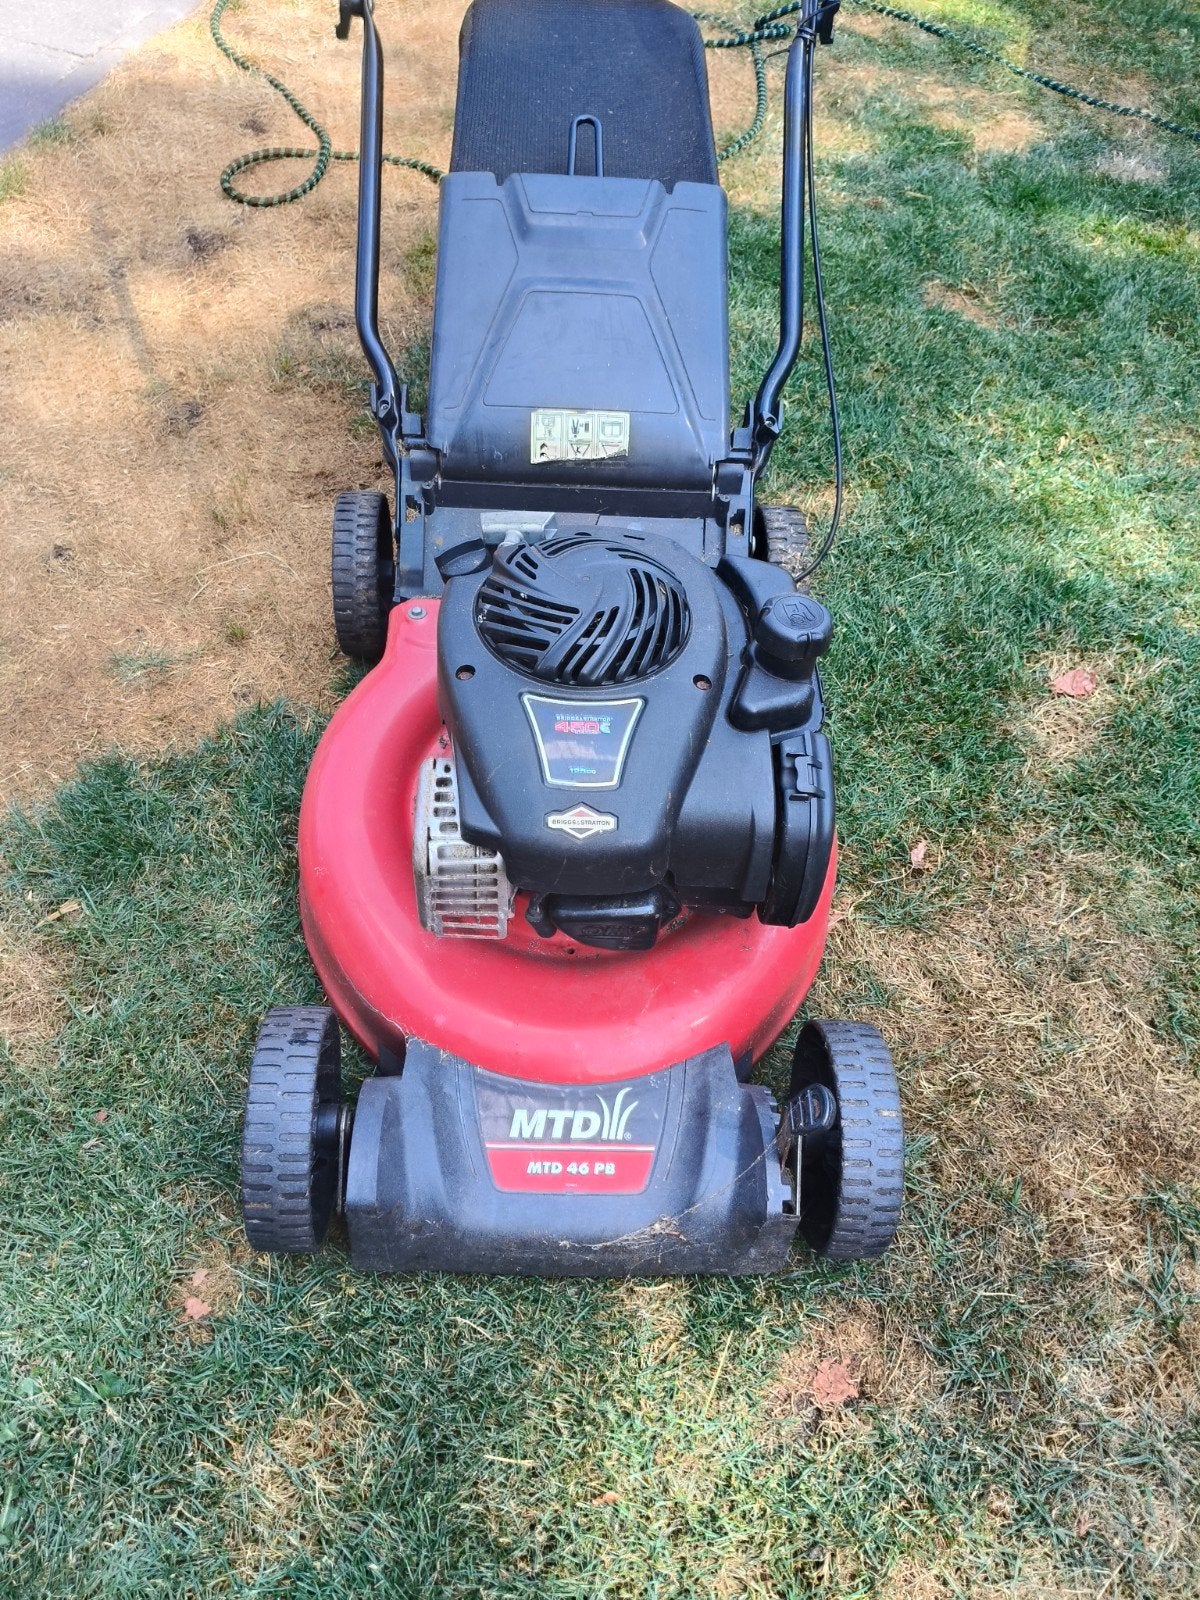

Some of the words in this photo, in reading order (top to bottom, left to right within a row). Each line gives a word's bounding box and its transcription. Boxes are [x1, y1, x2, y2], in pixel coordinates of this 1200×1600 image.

[526, 1161, 563, 1175] MTD
[566, 1162, 590, 1176] 46
[593, 1162, 616, 1176] PB
